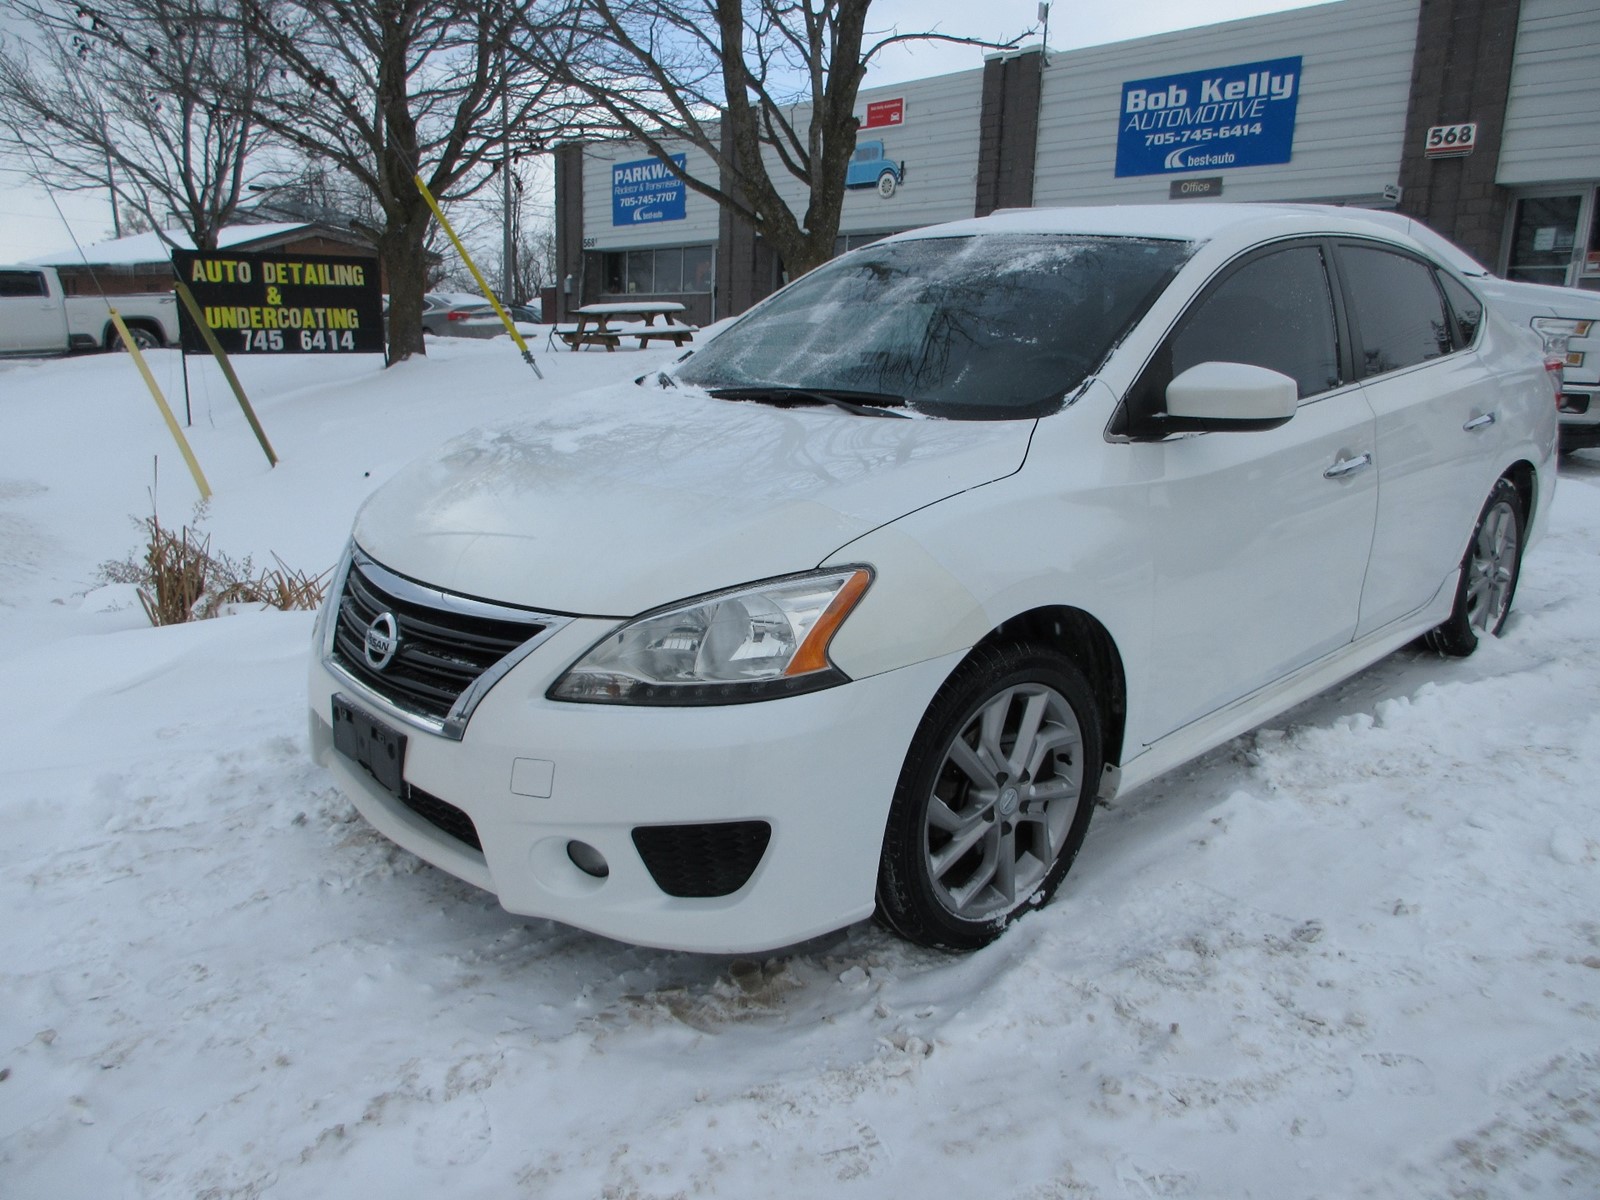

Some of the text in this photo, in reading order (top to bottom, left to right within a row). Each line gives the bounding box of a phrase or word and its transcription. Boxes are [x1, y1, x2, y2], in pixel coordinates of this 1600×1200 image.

[1126, 71, 1294, 113] Bob Kelly
[1125, 97, 1268, 132] AUTOMOTIVE
[1145, 122, 1263, 147] 705-745-6414
[1430, 126, 1472, 147] 568
[1181, 181, 1210, 194] Office
[192, 259, 365, 286] AUTO DETAILING
[266, 286, 282, 305] &
[205, 306, 360, 329] UNDERCOATING
[241, 330, 355, 351] 745 6414
